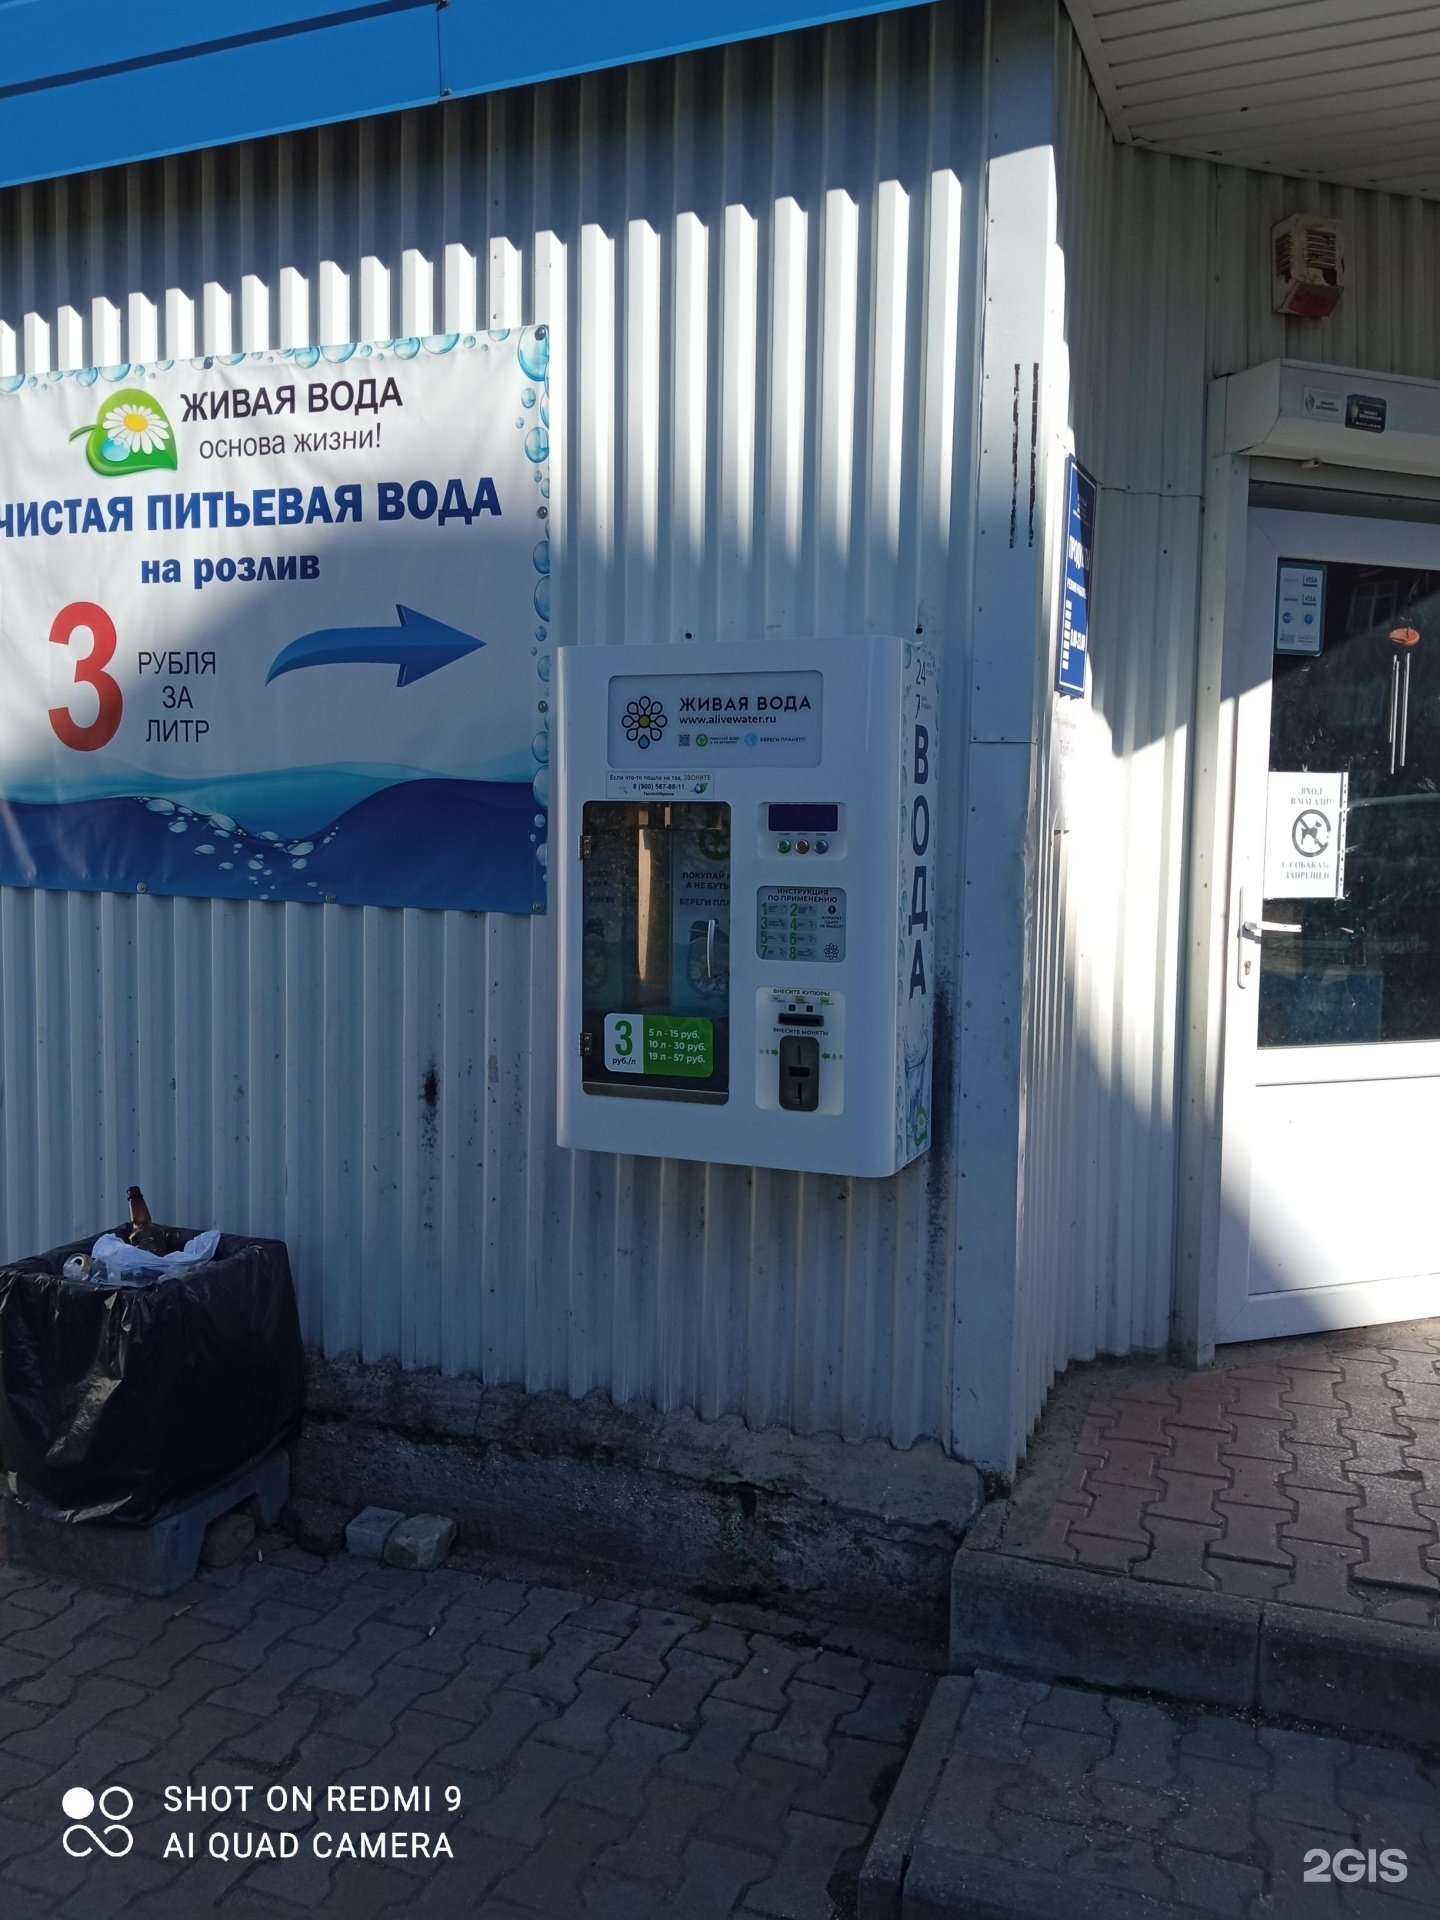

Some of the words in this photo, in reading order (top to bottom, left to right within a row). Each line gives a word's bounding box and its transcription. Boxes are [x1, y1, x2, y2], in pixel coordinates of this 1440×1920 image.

[180, 384, 295, 422] ЖИВАЯ
[308, 377, 403, 416] ВОДА
[200, 434, 285, 459] основа
[294, 422, 381, 453] жизни!
[147, 484, 362, 530] ПИТЬЕВАЯ
[377, 477, 502, 526] ВОДА
[141, 558, 181, 583] на
[193, 555, 320, 589] розлив
[138, 651, 216, 675] РУБЛЯ
[48, 601, 123, 752] 3
[161, 685, 193, 709] ЗА
[679, 697, 749, 712] ЖИВАЯ
[757, 696, 812, 712] ВОДА
[146, 719, 209, 742] ЛИТР
[679, 714, 777, 725] www.alivewater.ru
[908, 724, 930, 1000] ВОДА
[614, 1020, 633, 1056] 3
[648, 1029, 654, 1037] 5
[670, 1029, 679, 1037] 15
[680, 1030, 700, 1040] руб.
[649, 1040, 658, 1048] 10
[673, 1042, 685, 1050] 30
[687, 1043, 706, 1052] руб.
[612, 1057, 636, 1066] руб./л
[649, 1052, 658, 1060] 19
[673, 1054, 685, 1062] 57
[686, 1055, 705, 1064] руб.
